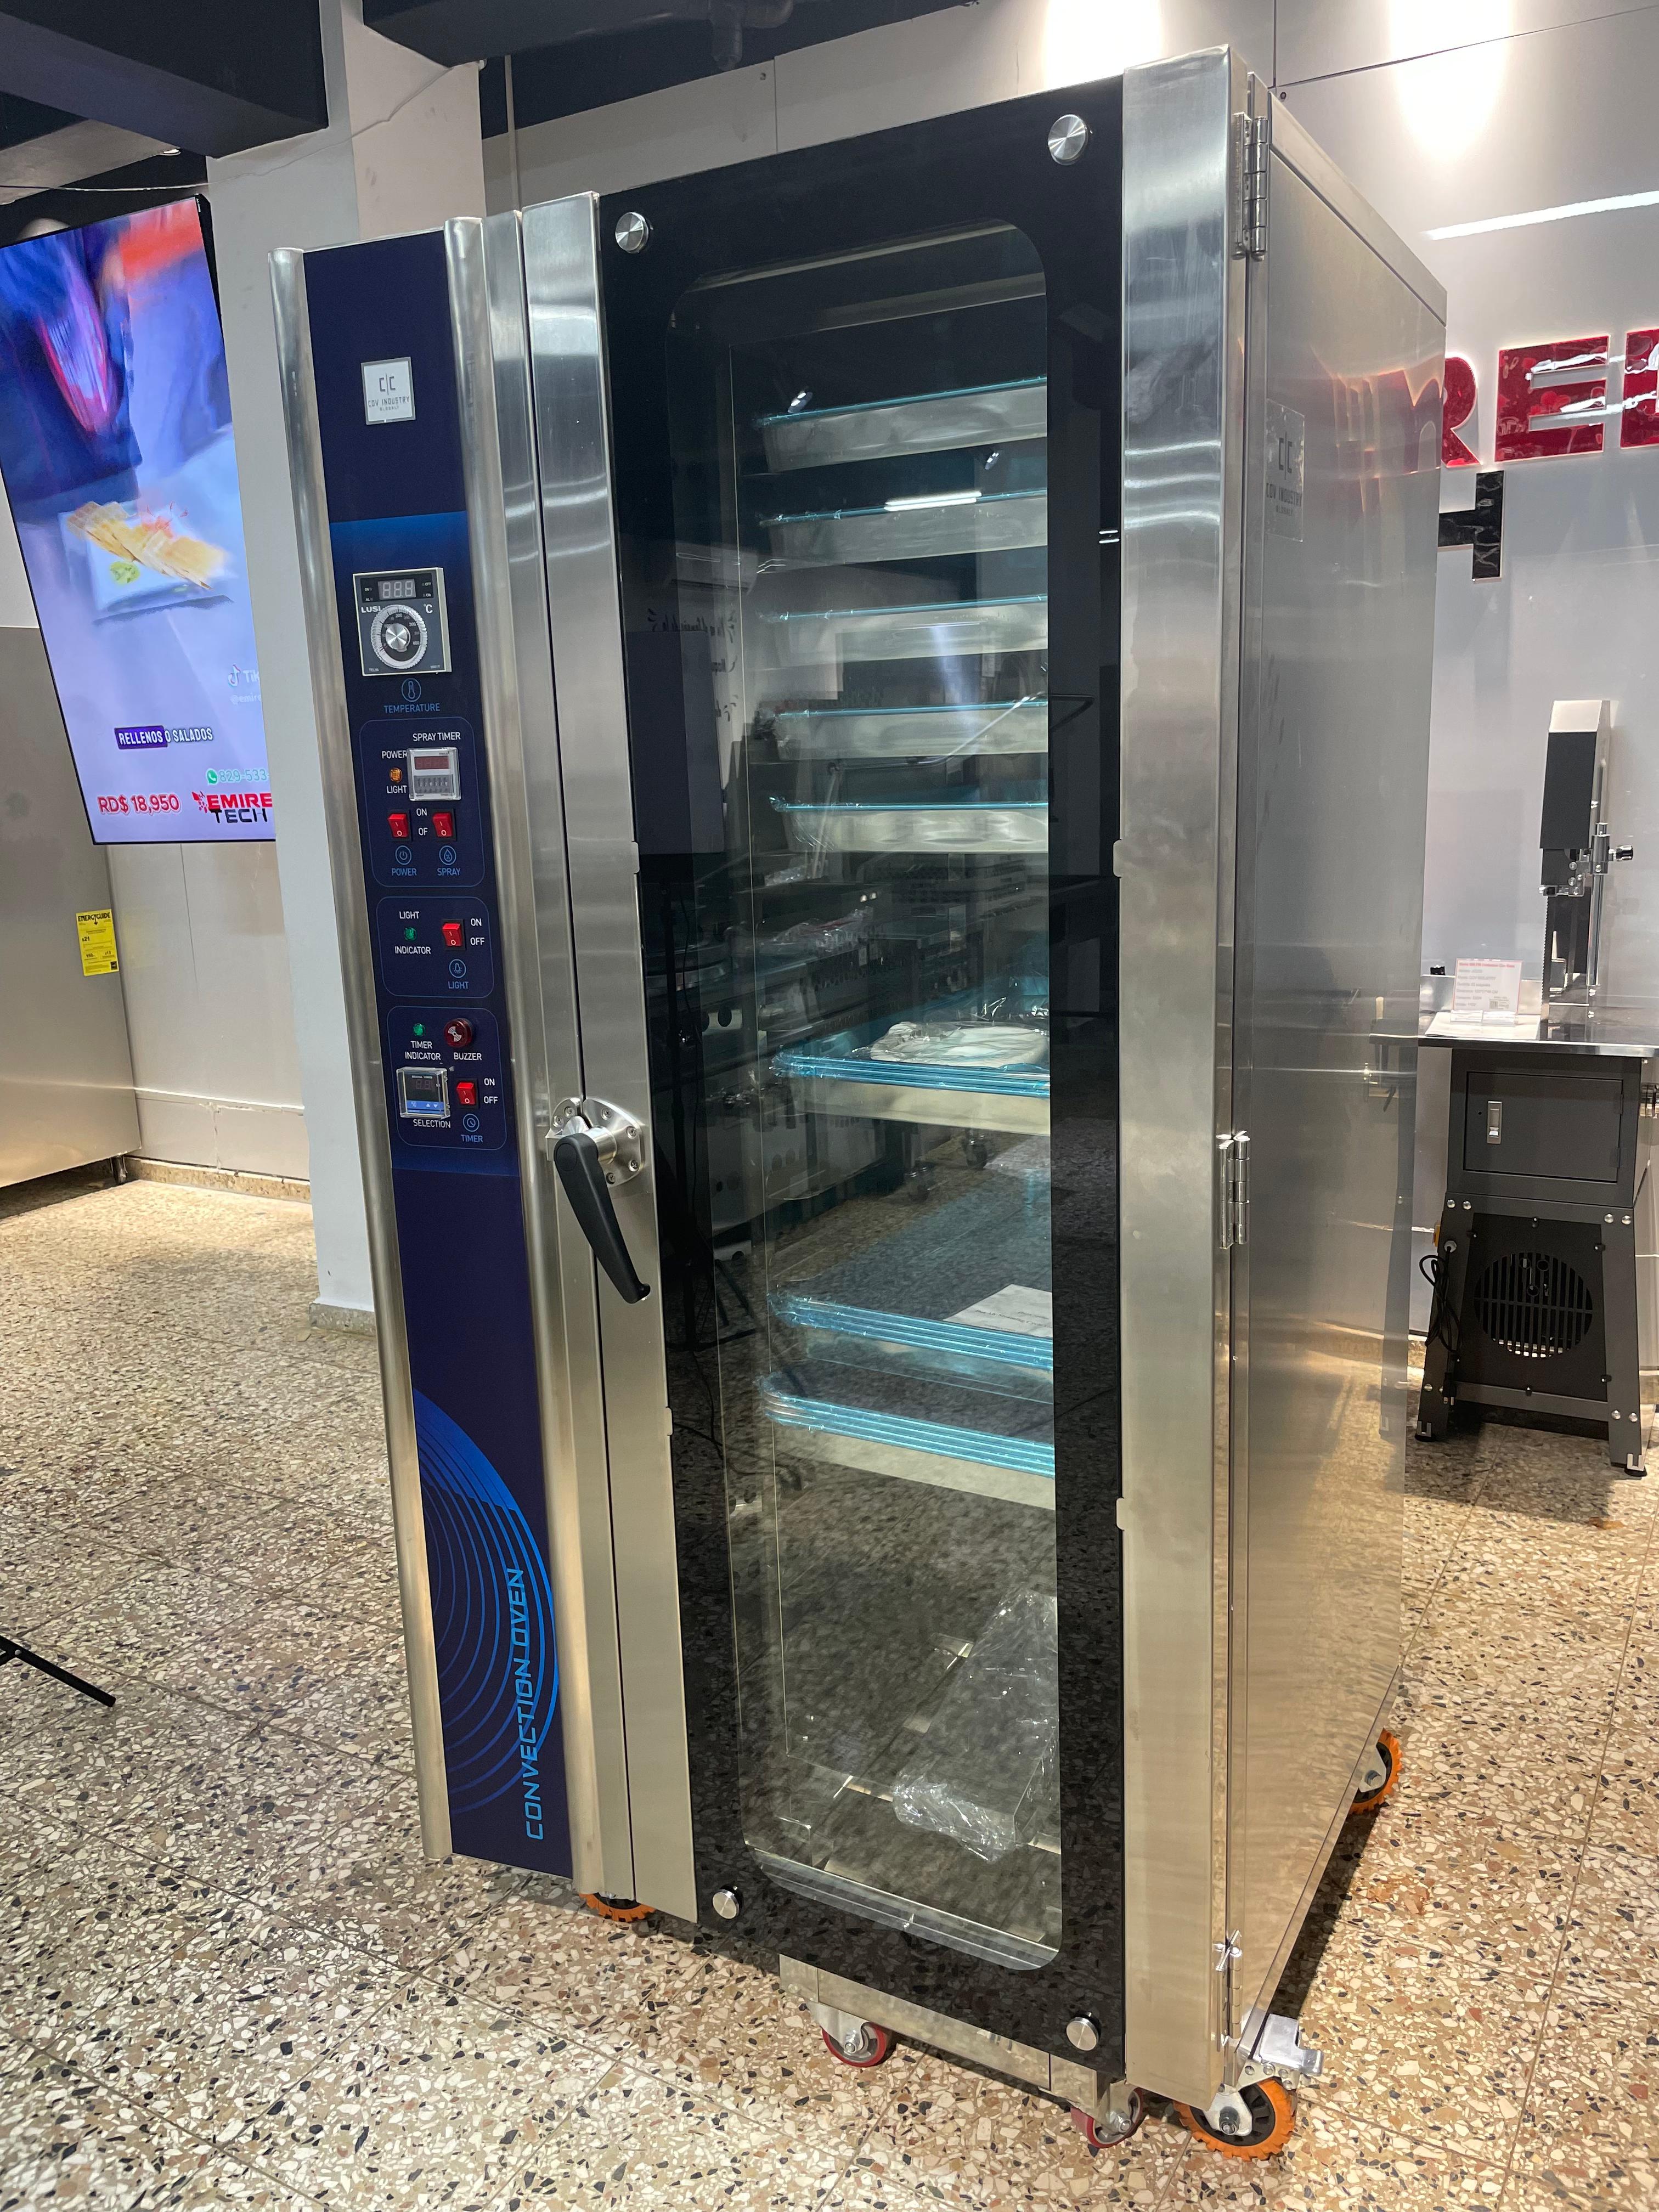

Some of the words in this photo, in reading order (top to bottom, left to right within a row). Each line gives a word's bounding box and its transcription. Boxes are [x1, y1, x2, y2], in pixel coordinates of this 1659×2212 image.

[384, 703, 441, 713] TEMPERATURE
[118, 730, 163, 745] RELLENOS
[165, 730, 171, 742] O
[172, 727, 213, 742] SALADOS
[413, 732, 436, 741] SPRAY
[437, 731, 461, 740] TIMER
[382, 750, 407, 759] POWER
[386, 785, 408, 794] LIGHT
[98, 795, 128, 813] RD$
[131, 794, 180, 814] 18,950
[206, 793, 273, 809] EMIRE
[209, 808, 268, 824] TECH
[416, 808, 427, 816] ON
[418, 827, 428, 836] OF
[391, 868, 417, 876] POWER
[437, 867, 461, 876] SPRAY
[399, 911, 420, 919] LIGHT
[470, 918, 482, 927] ON
[470, 937, 485, 945] OFF
[394, 946, 431, 955] INDICATOR
[448, 981, 470, 989] LIGHT
[410, 1040, 432, 1049] TIMER
[404, 1051, 441, 1060] INDICATOR
[453, 1052, 482, 1061] BUZZER
[484, 1078, 495, 1086] ON
[483, 1096, 498, 1104] OFF
[413, 1119, 451, 1128] SELECTION
[460, 1134, 483, 1143] TIMER
[506, 1567, 529, 1647] OVEN
[514, 1657, 544, 1841] CONVECTION
